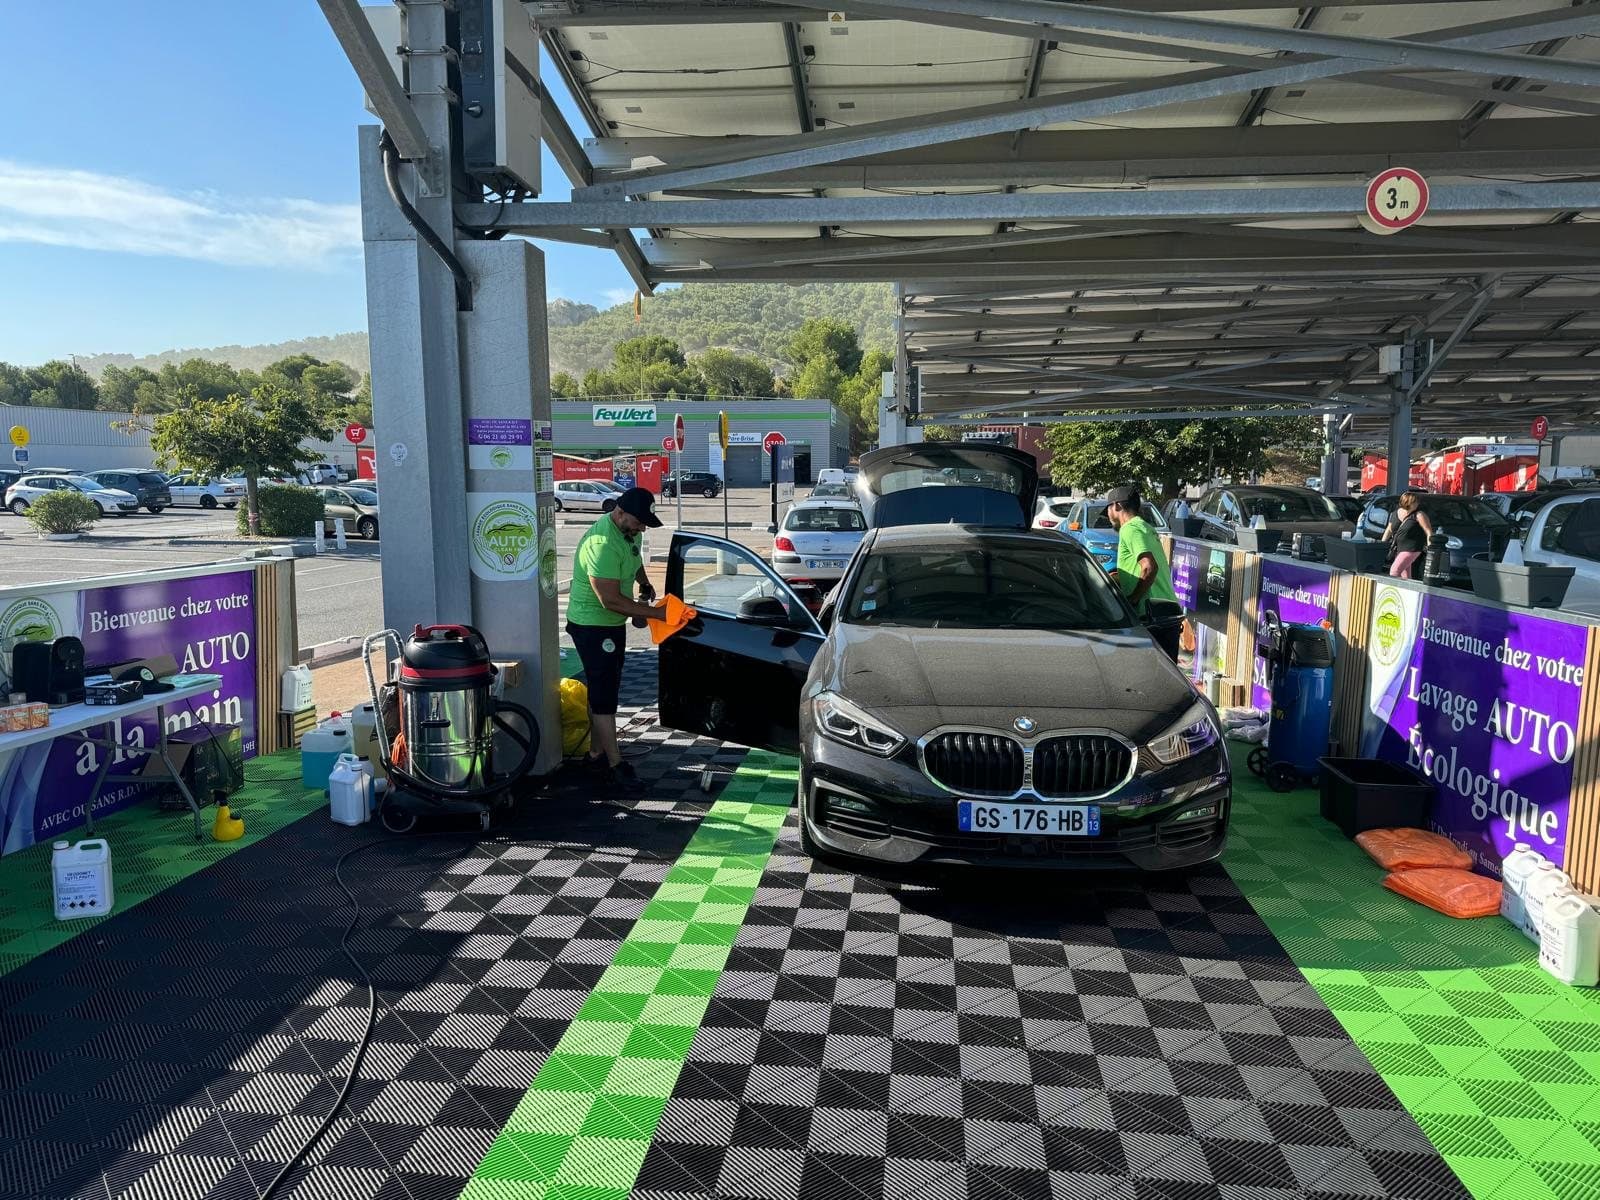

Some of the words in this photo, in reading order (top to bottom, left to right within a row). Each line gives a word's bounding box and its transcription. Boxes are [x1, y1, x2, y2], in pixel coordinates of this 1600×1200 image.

[1386, 188, 1397, 209] 3
[1400, 200, 1409, 209] m
[595, 408, 621, 420] Feu
[621, 408, 655, 420] Vert
[765, 440, 784, 448] STOP
[489, 535, 527, 547] AUTO
[1262, 576, 1295, 600] Bienvenue
[1295, 585, 1312, 605] chez
[1313, 592, 1329, 609] votr
[89, 606, 176, 633] Bienvenue
[180, 597, 212, 618] chez
[216, 593, 249, 610] votre
[180, 631, 250, 674] AUTO
[1421, 617, 1491, 659] Bienvenue
[1494, 638, 1531, 671] chez
[1536, 655, 1584, 687] votre
[1253, 657, 1268, 689] SA
[1408, 666, 1478, 732] Lavage
[1483, 697, 1575, 764] AUTO
[75, 730, 100, 776] à
[111, 716, 146, 765] la
[165, 689, 243, 736] main
[242, 740, 255, 753] 19H
[1406, 722, 1558, 845] Écologique
[40, 808, 71, 831] AVEC
[90, 791, 116, 812] SANS
[975, 807, 1084, 832] GS-176-HB
[1089, 820, 1099, 831] 13
